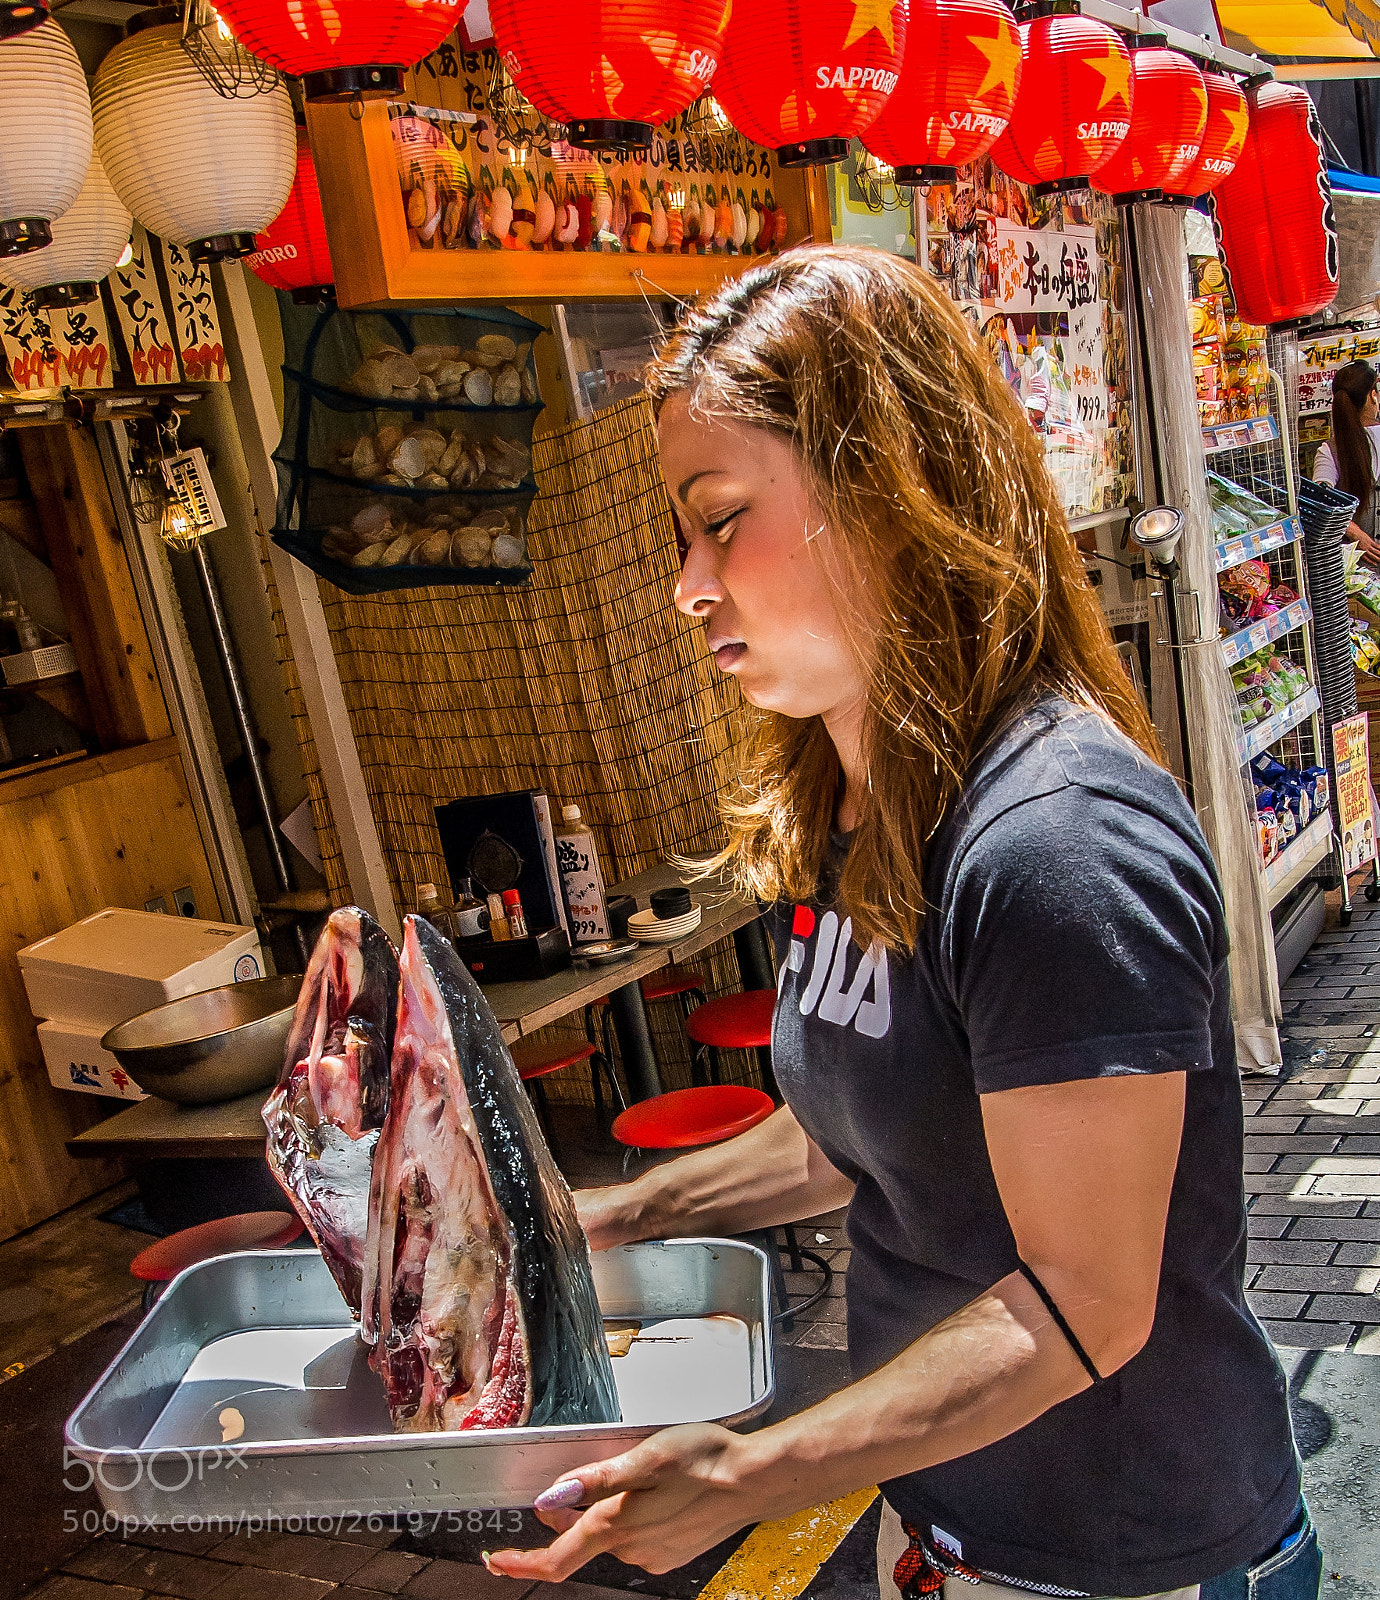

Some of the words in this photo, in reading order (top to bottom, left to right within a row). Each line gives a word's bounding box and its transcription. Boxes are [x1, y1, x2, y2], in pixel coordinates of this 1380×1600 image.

[815, 66, 899, 95] SAPPORO
[1299, 397, 1333, 412] 上野アメ
